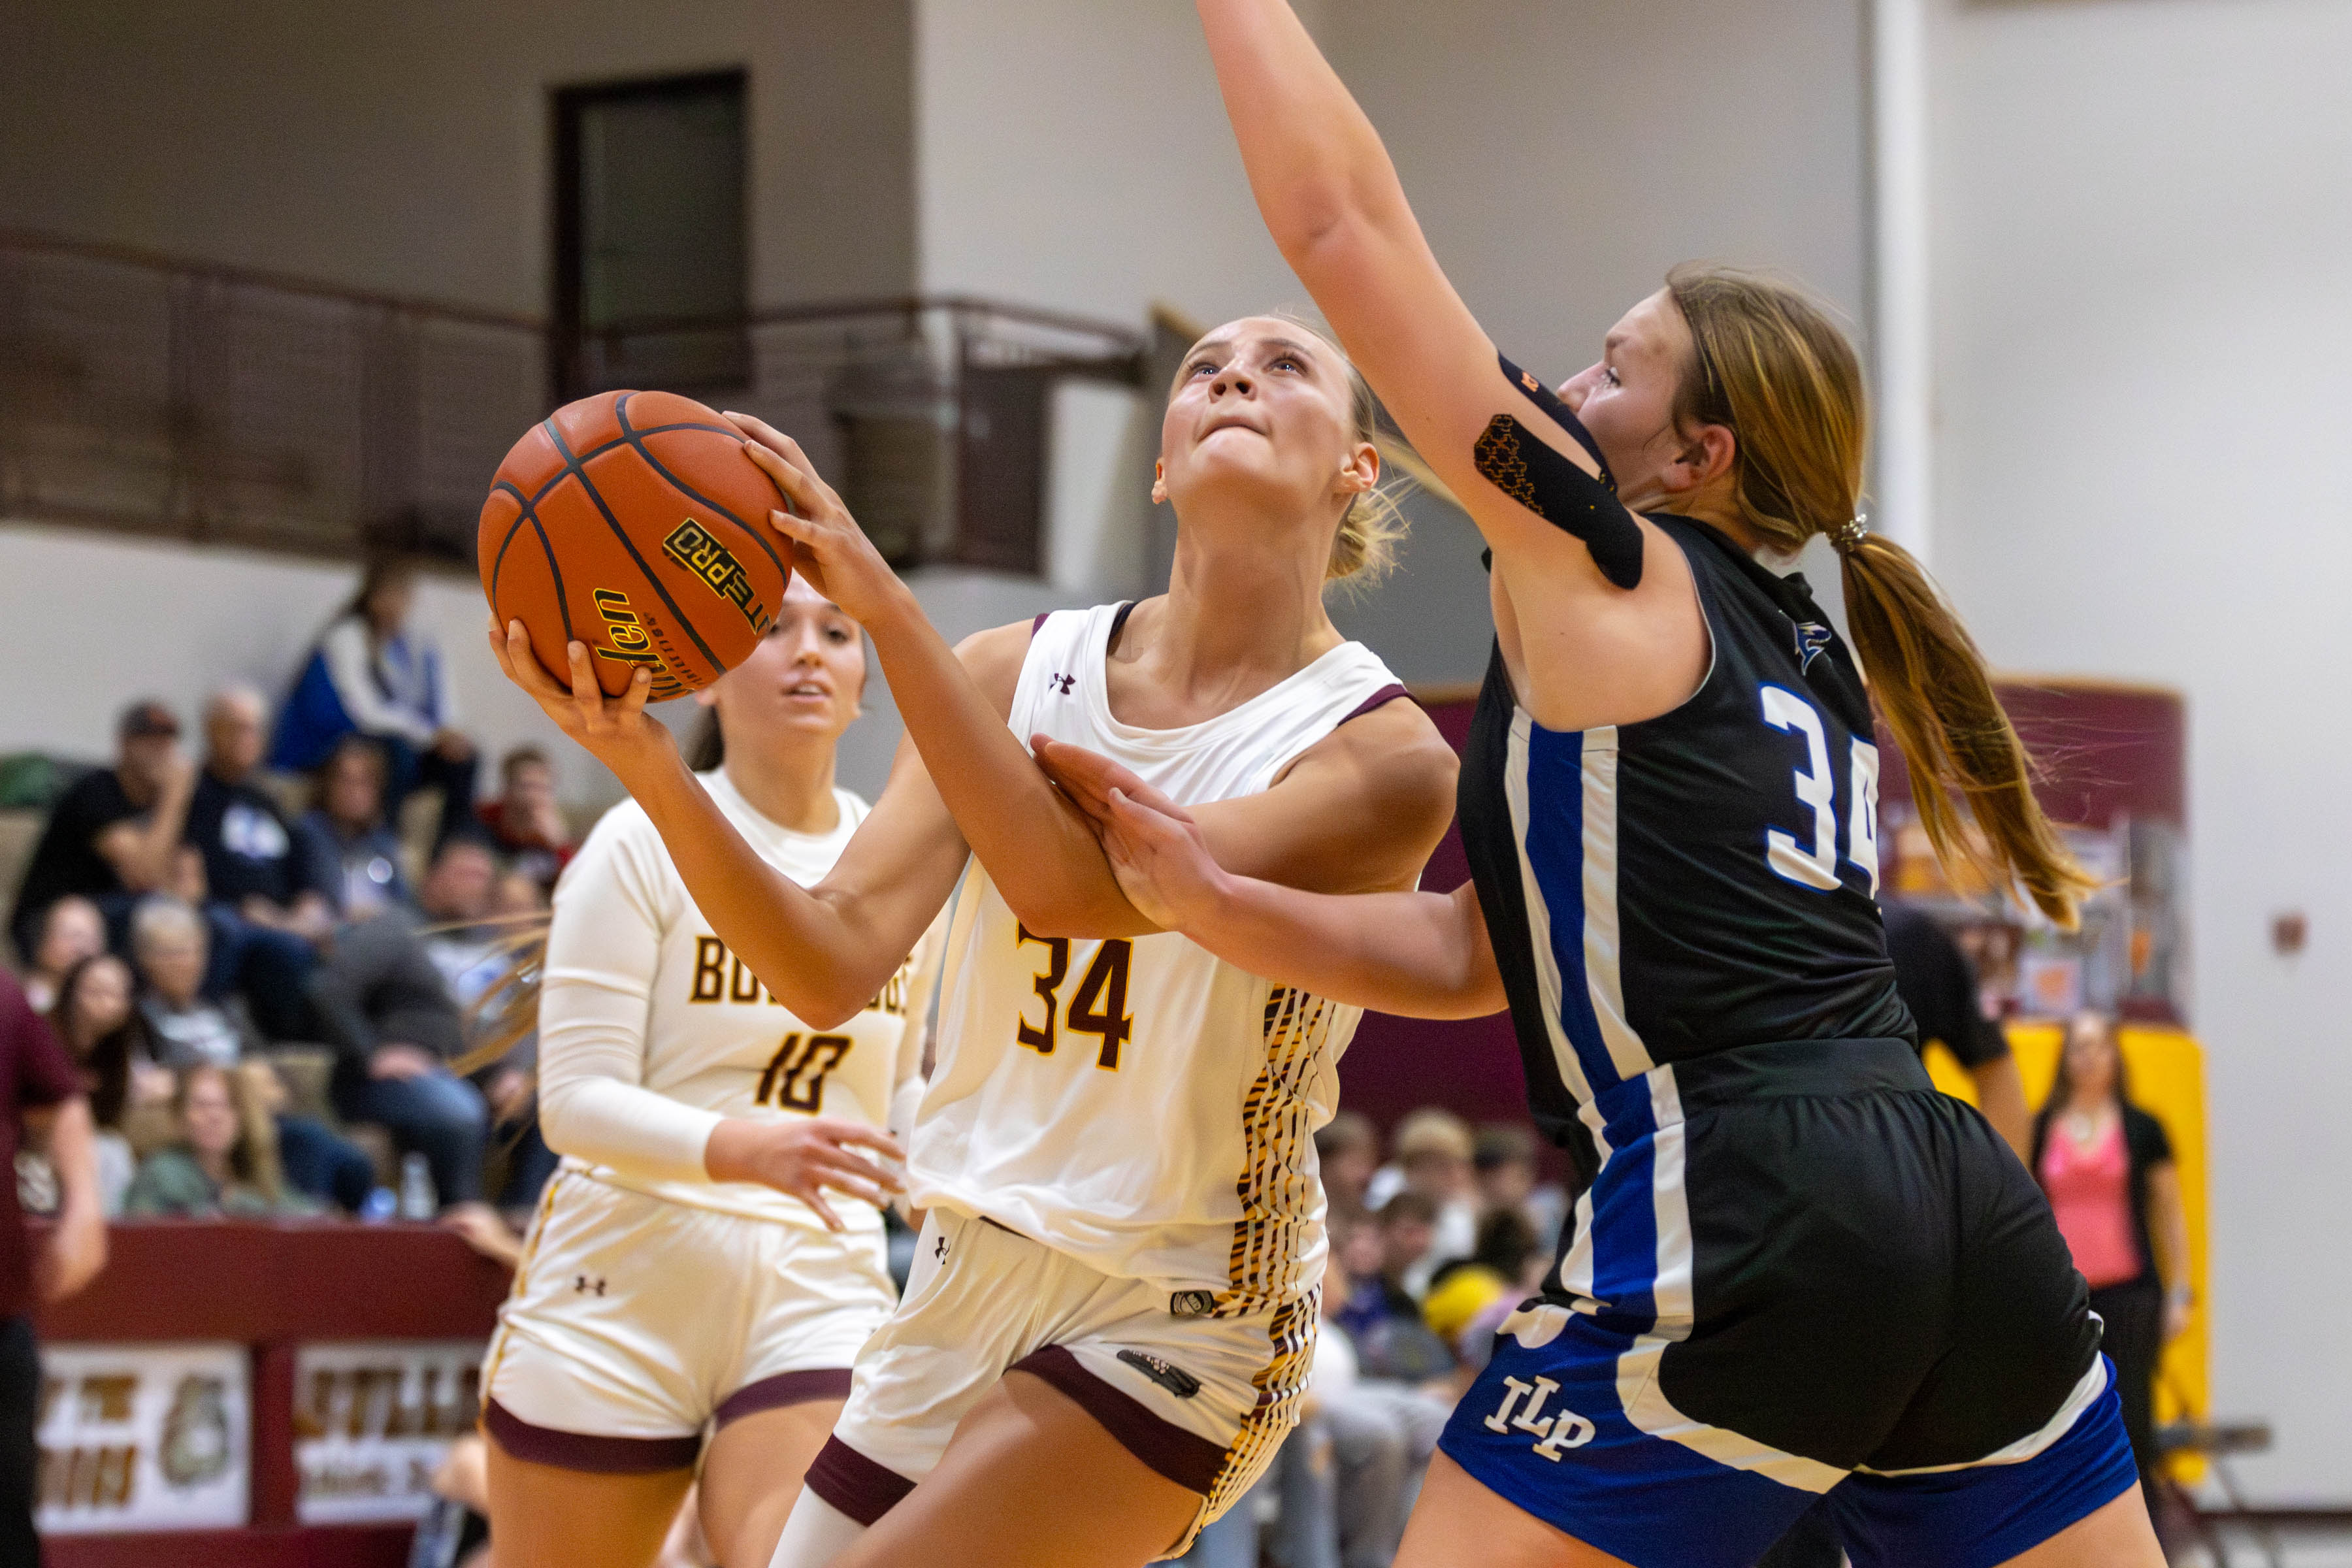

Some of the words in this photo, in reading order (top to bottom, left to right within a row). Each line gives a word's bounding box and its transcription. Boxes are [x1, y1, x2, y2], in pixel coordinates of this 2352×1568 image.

[1759, 681, 1880, 900] 34
[1016, 919, 1134, 1072] 34
[755, 1032, 854, 1114] 10
[1484, 1375, 1596, 1463] ILP
